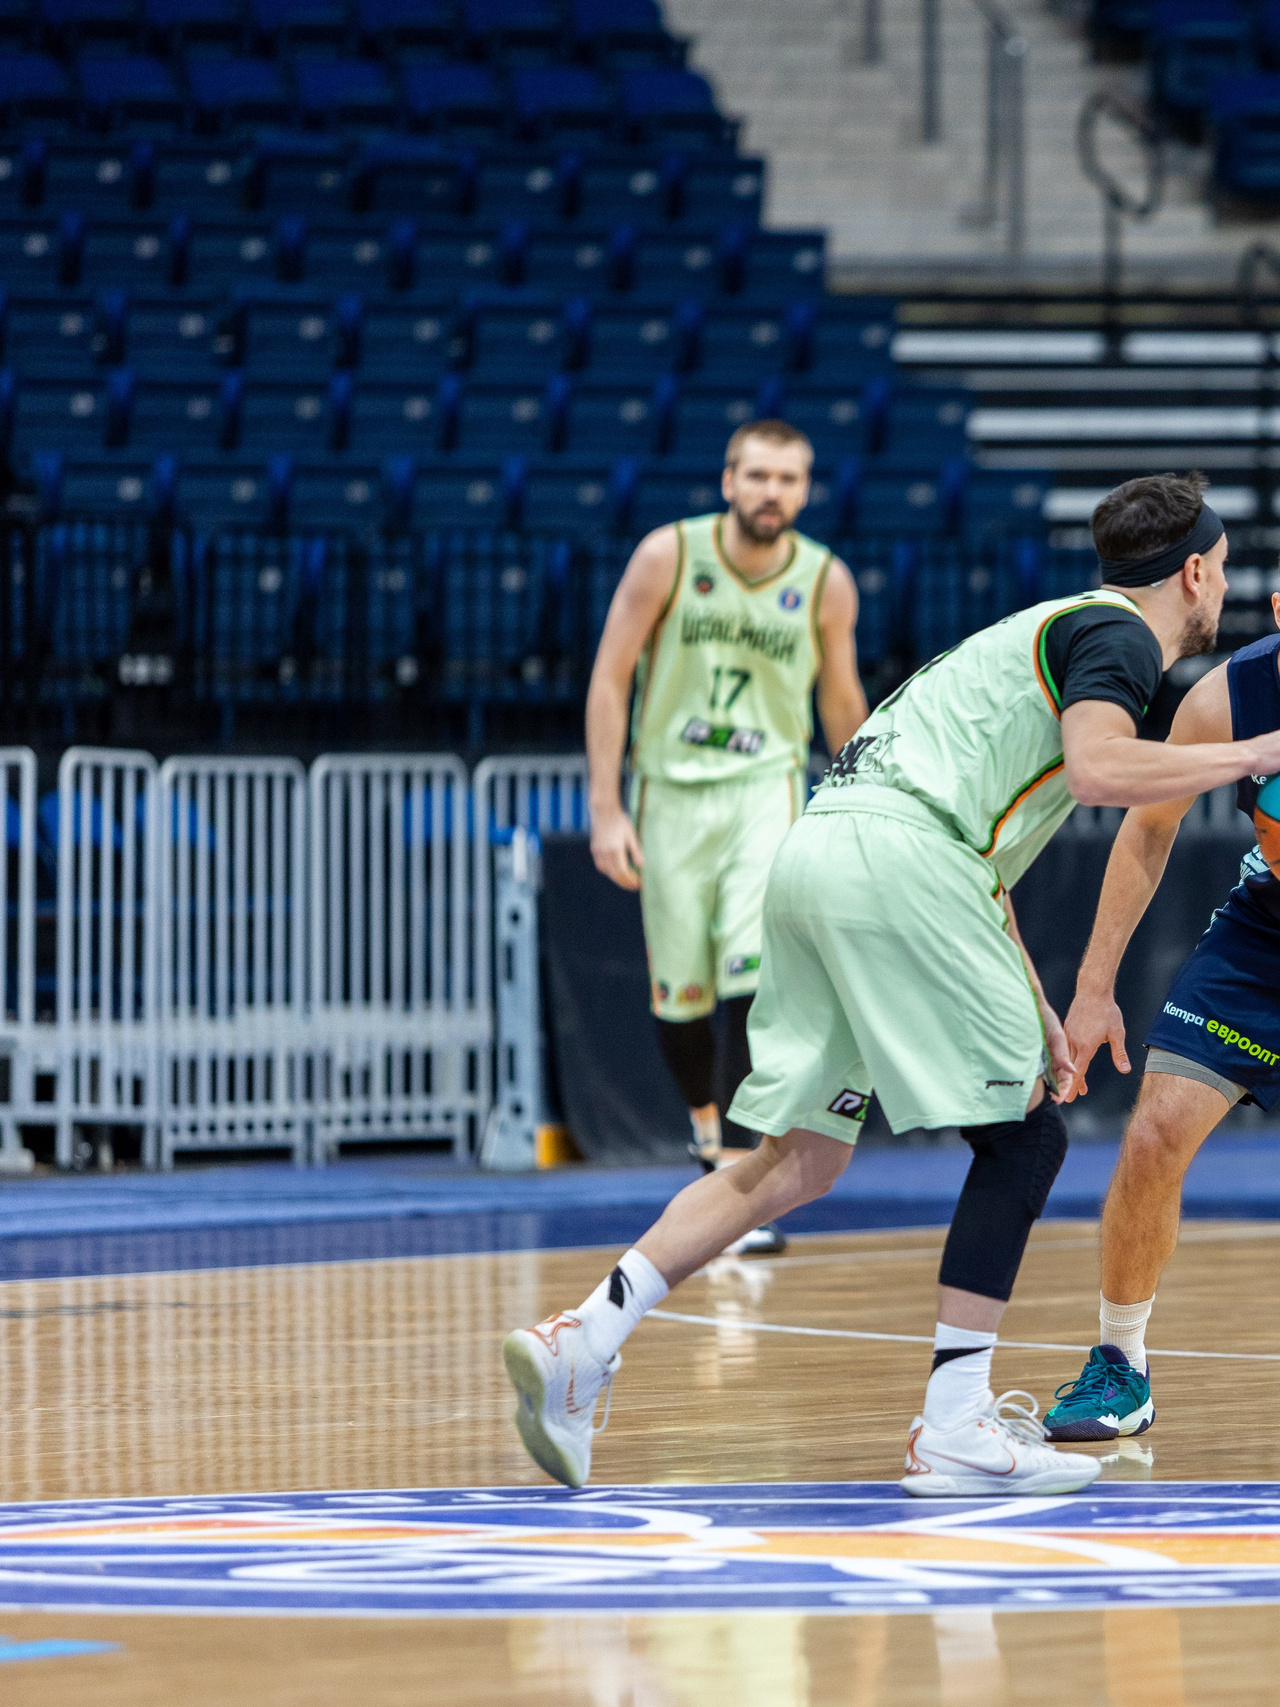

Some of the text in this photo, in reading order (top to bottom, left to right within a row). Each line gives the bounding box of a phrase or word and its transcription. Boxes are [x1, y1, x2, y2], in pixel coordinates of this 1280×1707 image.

[711, 666, 752, 710] 17
[1163, 1001, 1205, 1026] Kempa
[1206, 1019, 1280, 1066] евроопт
